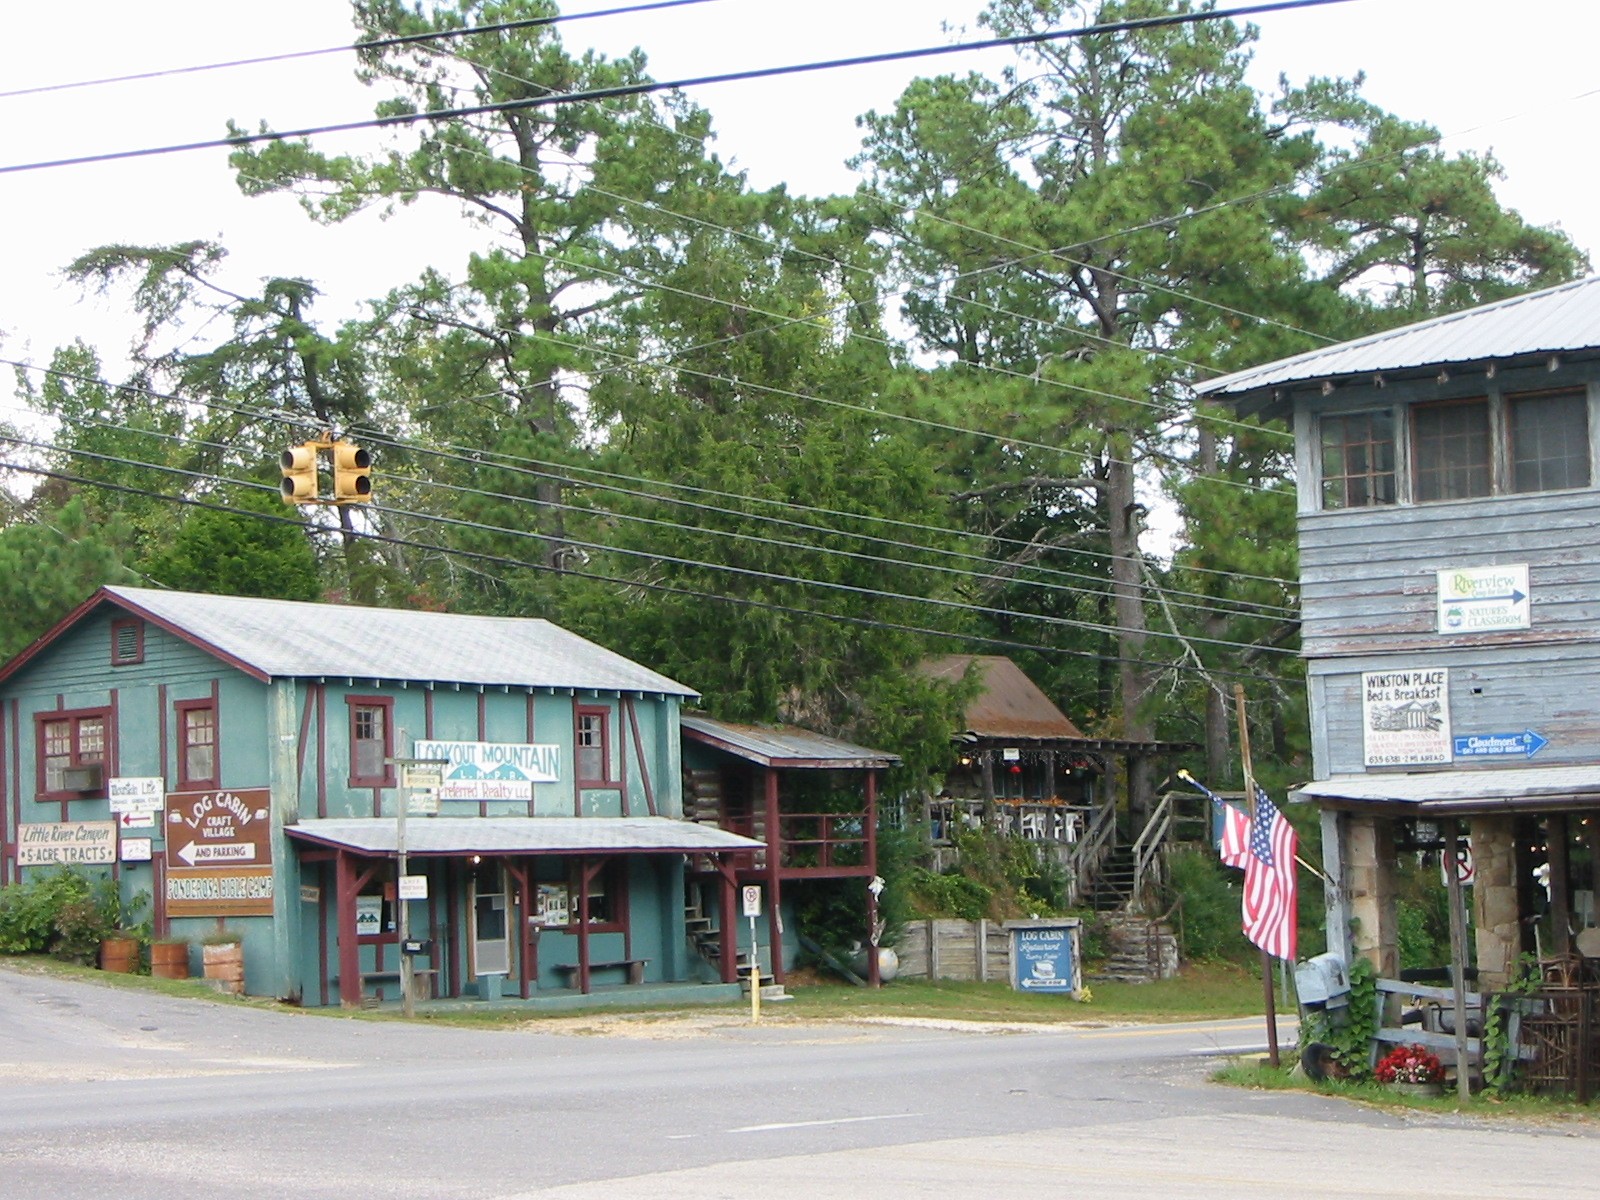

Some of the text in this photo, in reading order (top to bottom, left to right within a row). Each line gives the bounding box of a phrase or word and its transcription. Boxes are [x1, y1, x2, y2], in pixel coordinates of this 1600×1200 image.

[1454, 574, 1515, 593] Riverview
[1467, 614, 1521, 627] CLASSROOM
[1366, 671, 1444, 688] WINSTON PLACE
[1367, 689, 1383, 702] Bed
[1394, 686, 1441, 701] Breakfast
[1467, 736, 1517, 749] Cloudmont
[417, 743, 560, 781] LOOKOUT MOUNTAIN
[440, 781, 479, 799] referred
[482, 780, 513, 799] Realty
[513, 787, 529, 799] LLC
[185, 792, 253, 829] LOG CABIN
[206, 816, 233, 827] CRAFT
[23, 826, 50, 843] Little
[51, 825, 75, 842] River
[75, 825, 110, 845] Canyon
[202, 827, 236, 838] VILLAGE
[27, 846, 106, 862] 5-ACRE TRACTS
[195, 845, 246, 858] AND PARKING
[167, 877, 220, 900] PONDEROSA
[220, 876, 247, 900] BIBLE
[247, 875, 273, 899] CAMP
[1021, 930, 1065, 941] LOG CABIN
